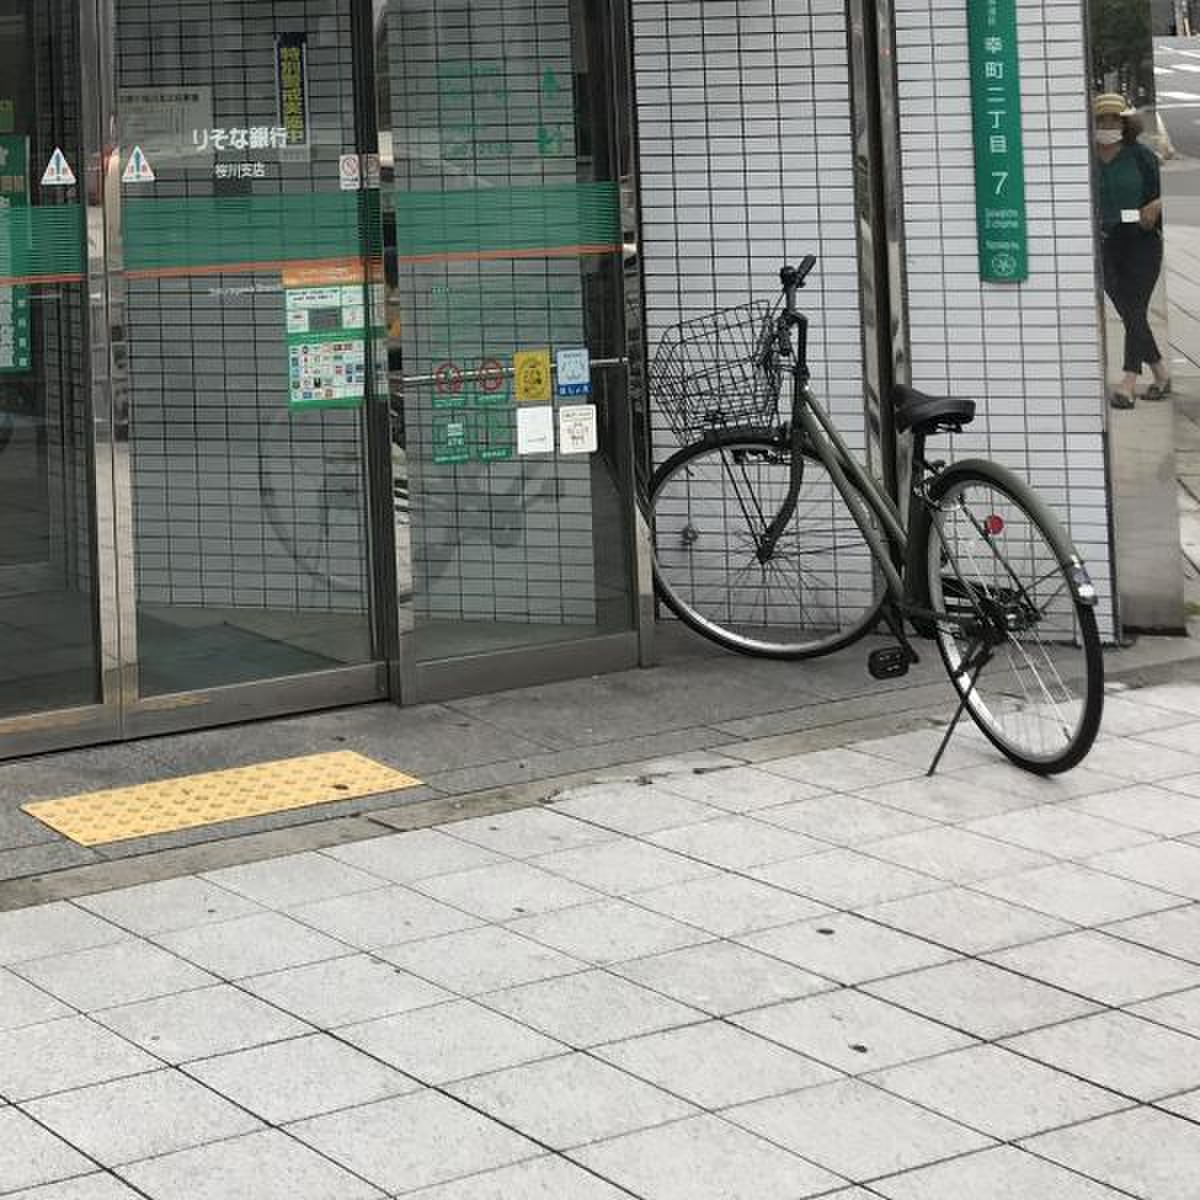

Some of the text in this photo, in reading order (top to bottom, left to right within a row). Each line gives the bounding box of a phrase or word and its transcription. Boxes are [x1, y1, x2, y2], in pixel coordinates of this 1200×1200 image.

[193, 126, 287, 150] りそな銀行
[215, 161, 265, 178] 桜川支店
[991, 171, 1009, 195] 7
